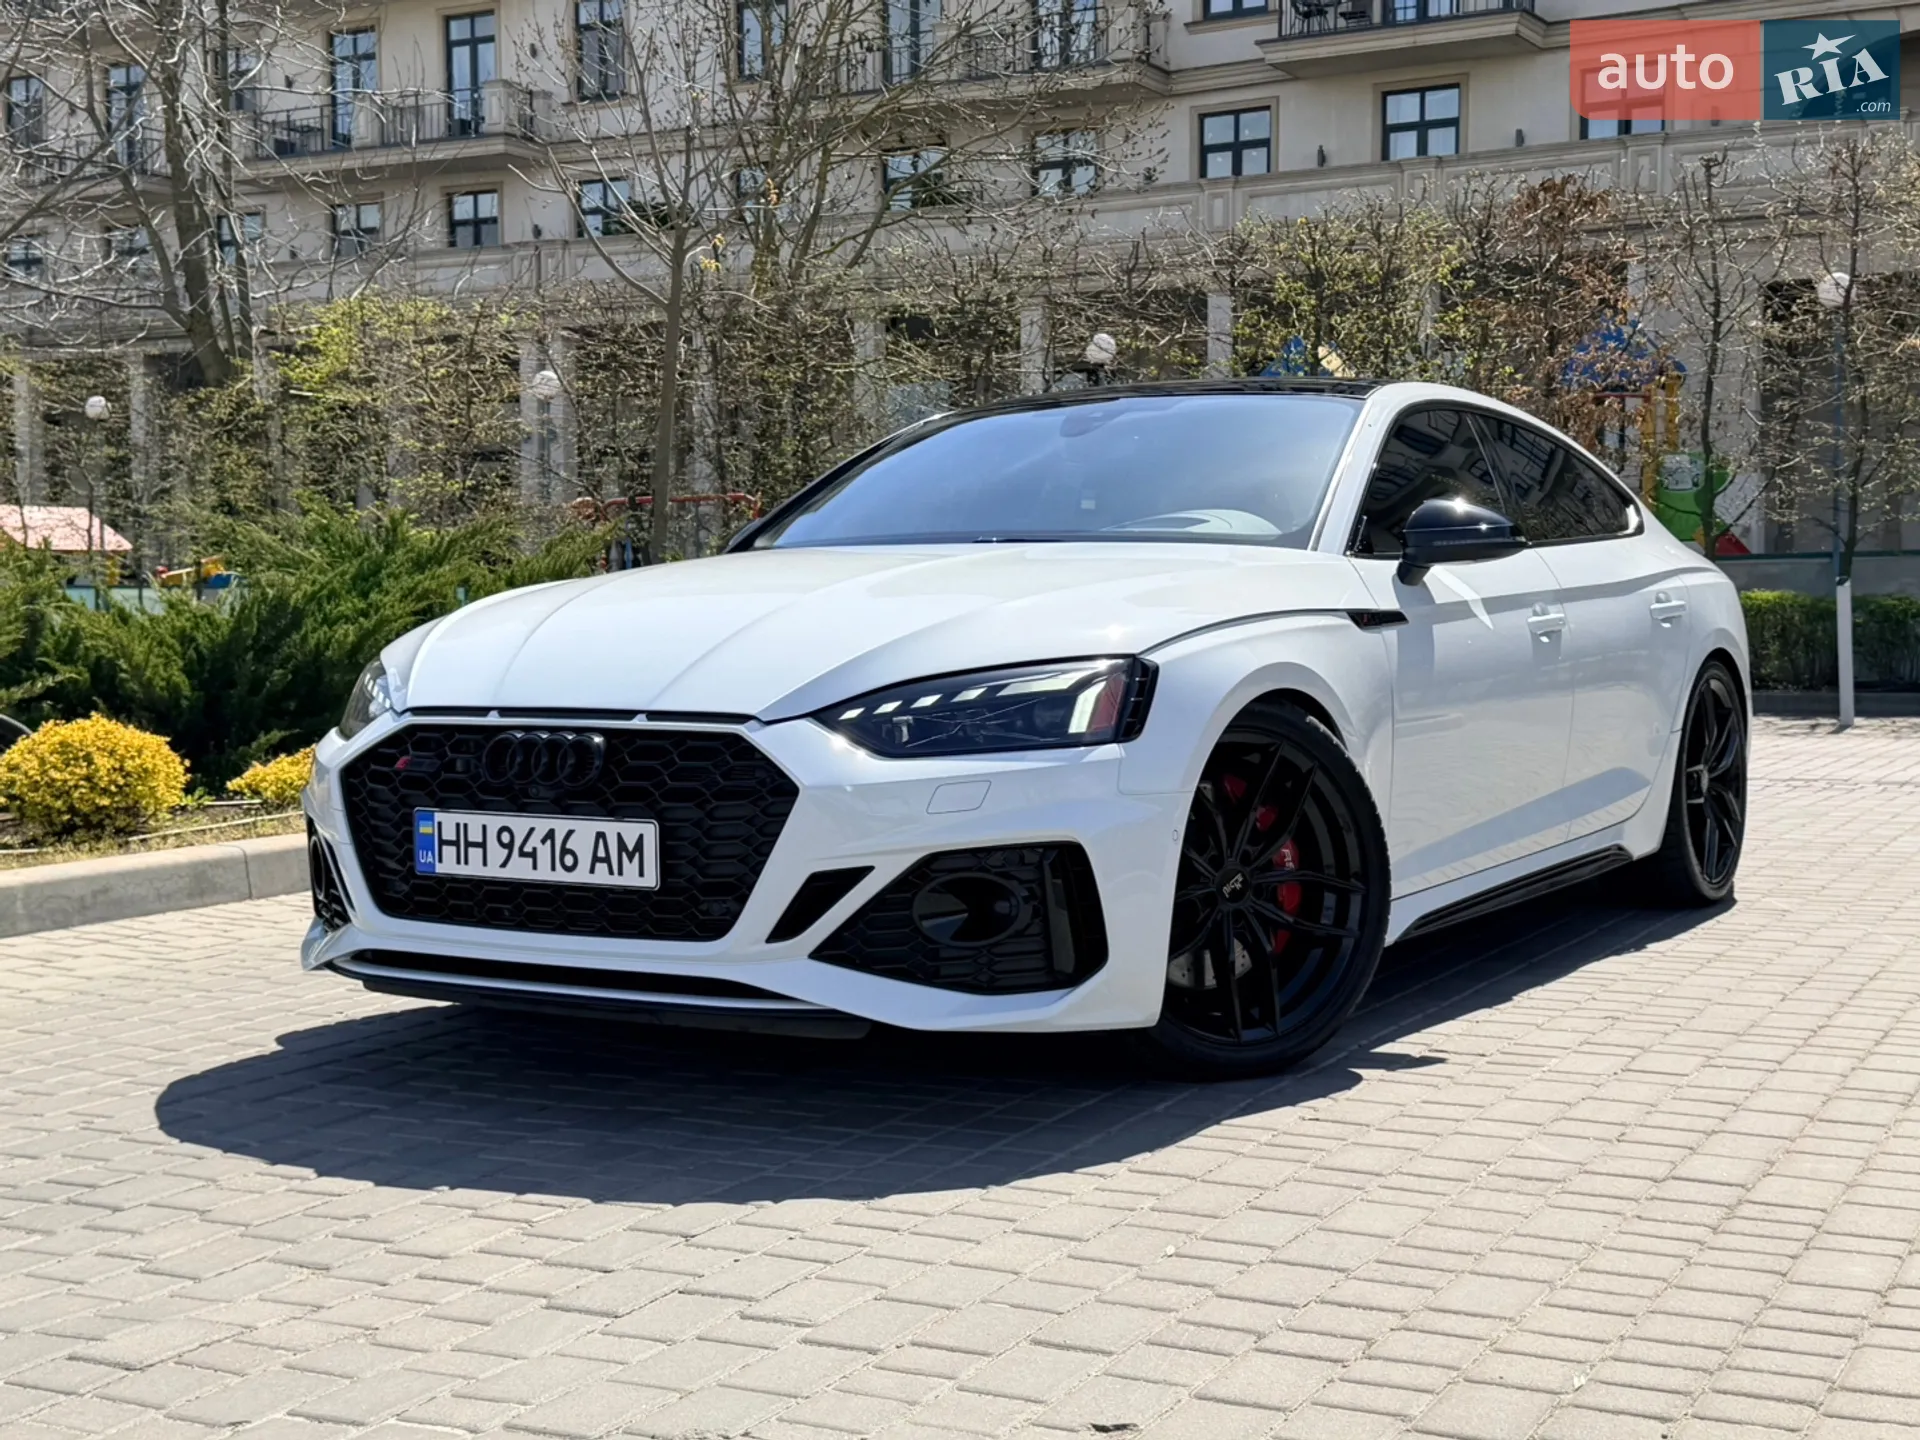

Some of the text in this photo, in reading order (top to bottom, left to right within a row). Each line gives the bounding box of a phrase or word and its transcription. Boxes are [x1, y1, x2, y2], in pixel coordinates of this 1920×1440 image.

[419, 850, 434, 865] UA
[437, 821, 645, 878] HH 9416 AM
